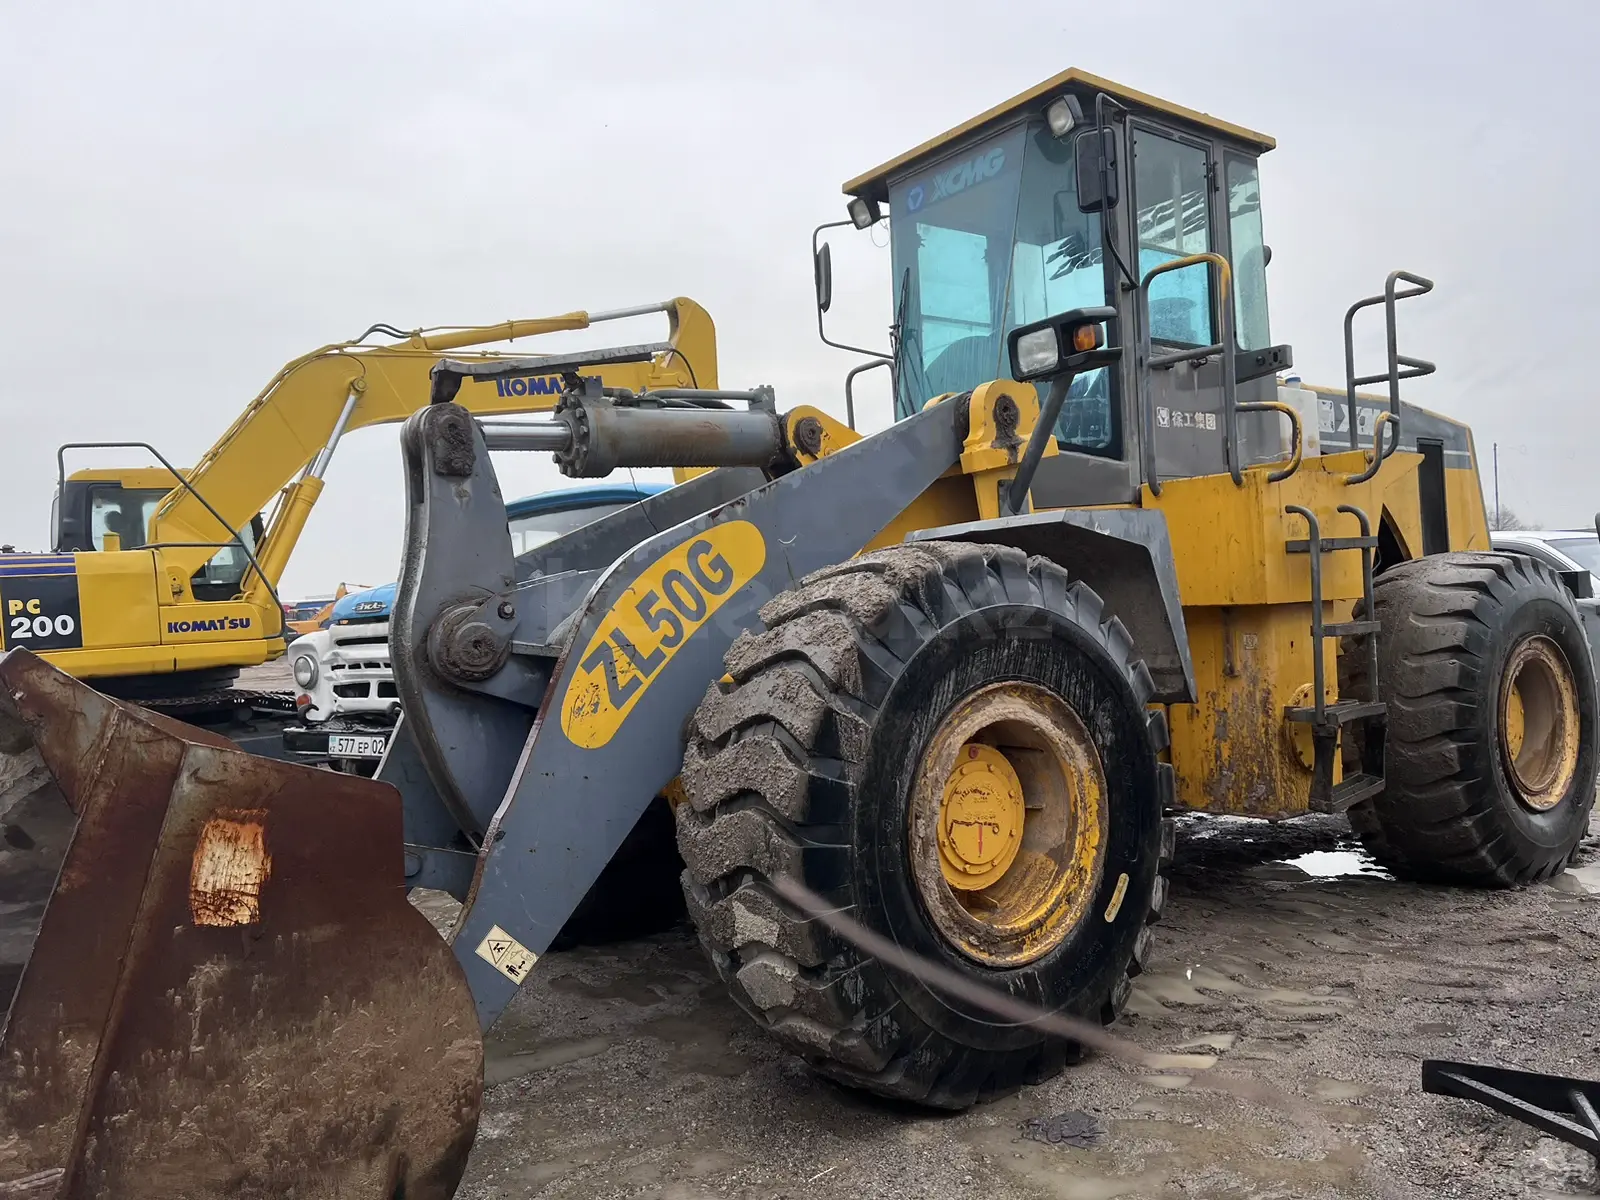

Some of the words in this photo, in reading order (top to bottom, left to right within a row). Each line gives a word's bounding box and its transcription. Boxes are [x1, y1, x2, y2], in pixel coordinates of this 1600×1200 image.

[930, 148, 1004, 201] XCMG
[496, 376, 602, 397] KOMA
[9, 598, 40, 615] PC
[11, 614, 75, 638] 200
[168, 616, 251, 633] KOMATSU
[581, 539, 733, 710] ZL50G
[338, 738, 355, 752] 577
[358, 742, 369, 753] EP
[372, 739, 384, 754] 02
